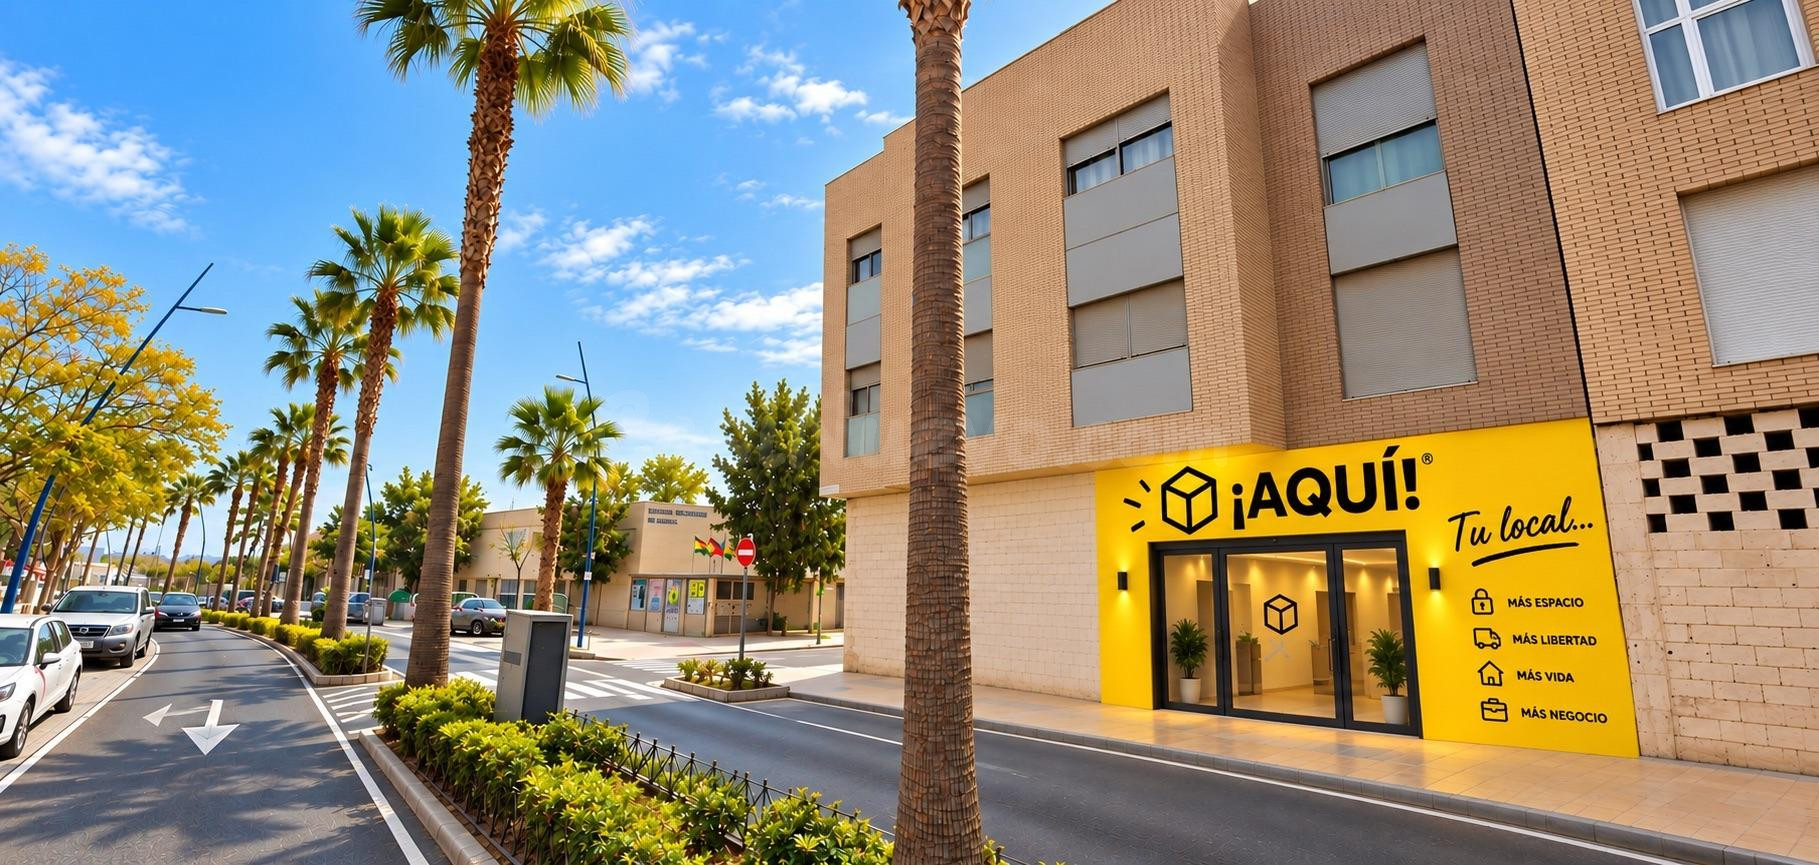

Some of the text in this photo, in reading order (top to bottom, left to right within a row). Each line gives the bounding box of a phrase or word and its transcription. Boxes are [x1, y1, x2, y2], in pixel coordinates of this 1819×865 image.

[1231, 445, 1420, 530] ¡AQUÍ!
[1448, 495, 1594, 552] Tu local...
[1507, 595, 1585, 608] MÁS ESPACIO
[1512, 632, 1597, 646] MÁS LIBERTAD
[1516, 668, 1575, 683] MÁS VIDA
[1520, 706, 1608, 724] MÁS NEGOCIO
